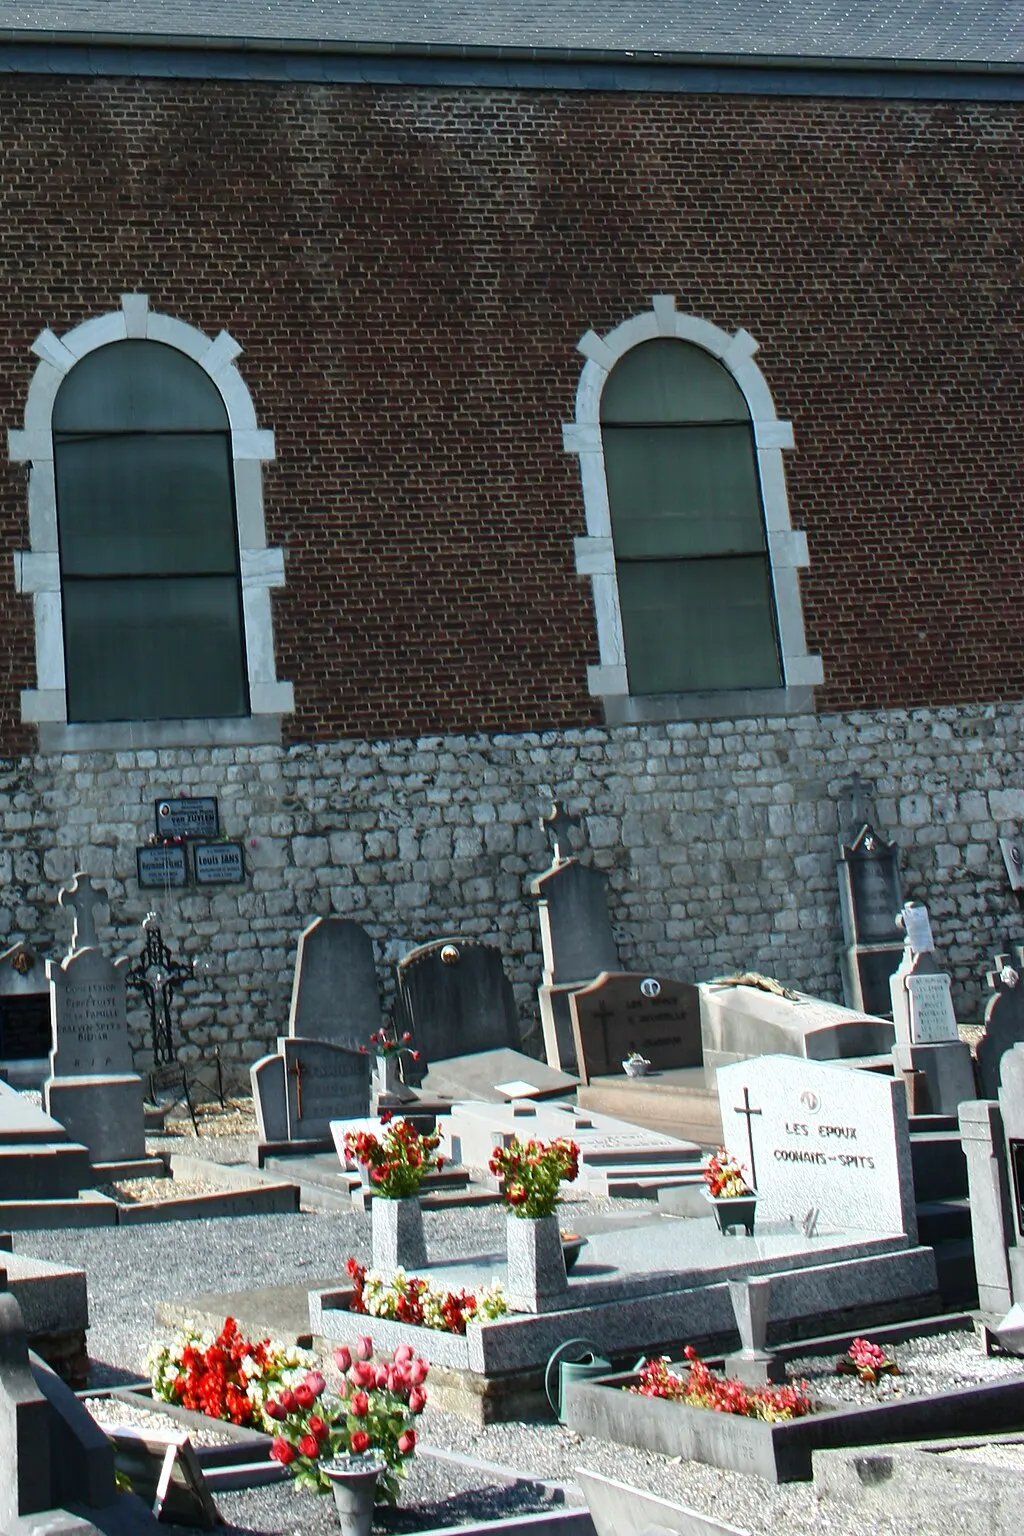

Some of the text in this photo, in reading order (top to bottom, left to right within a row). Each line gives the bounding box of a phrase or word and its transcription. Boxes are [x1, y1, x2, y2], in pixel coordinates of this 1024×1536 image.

[198, 855, 219, 865] Louis
[785, 1123, 857, 1140] LES EPOUX
